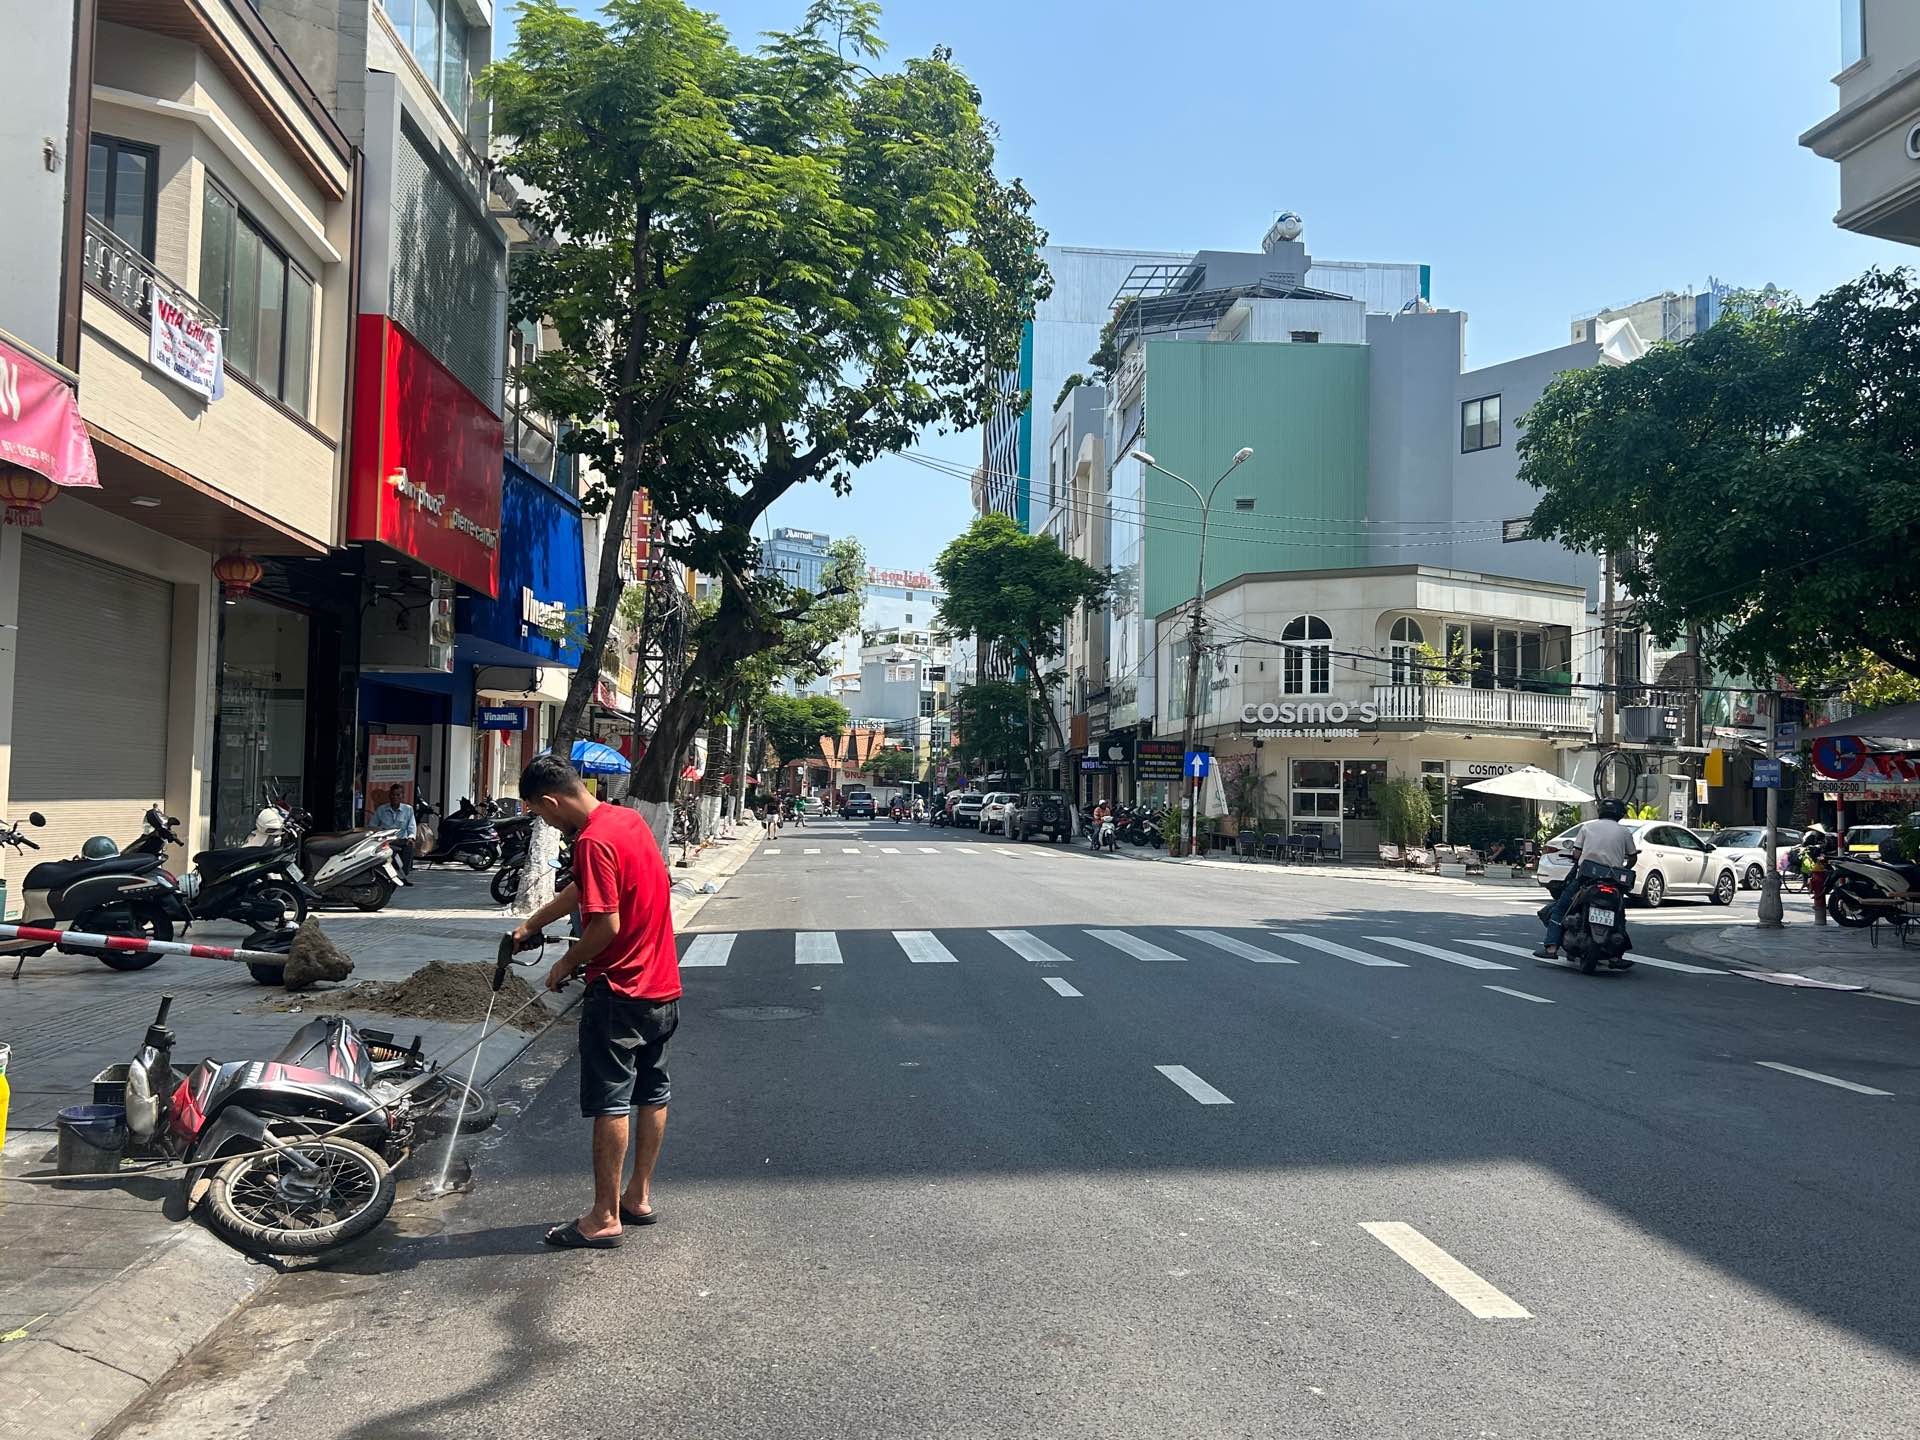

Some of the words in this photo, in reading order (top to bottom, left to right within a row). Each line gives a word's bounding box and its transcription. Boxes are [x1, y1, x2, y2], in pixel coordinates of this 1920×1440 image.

[483, 711, 518, 721] Vinamilk
[1256, 728, 1293, 738] COFFEE
[1294, 729, 1301, 738] &
[1302, 728, 1321, 738] TEA
[1324, 728, 1360, 738] HOUSE
